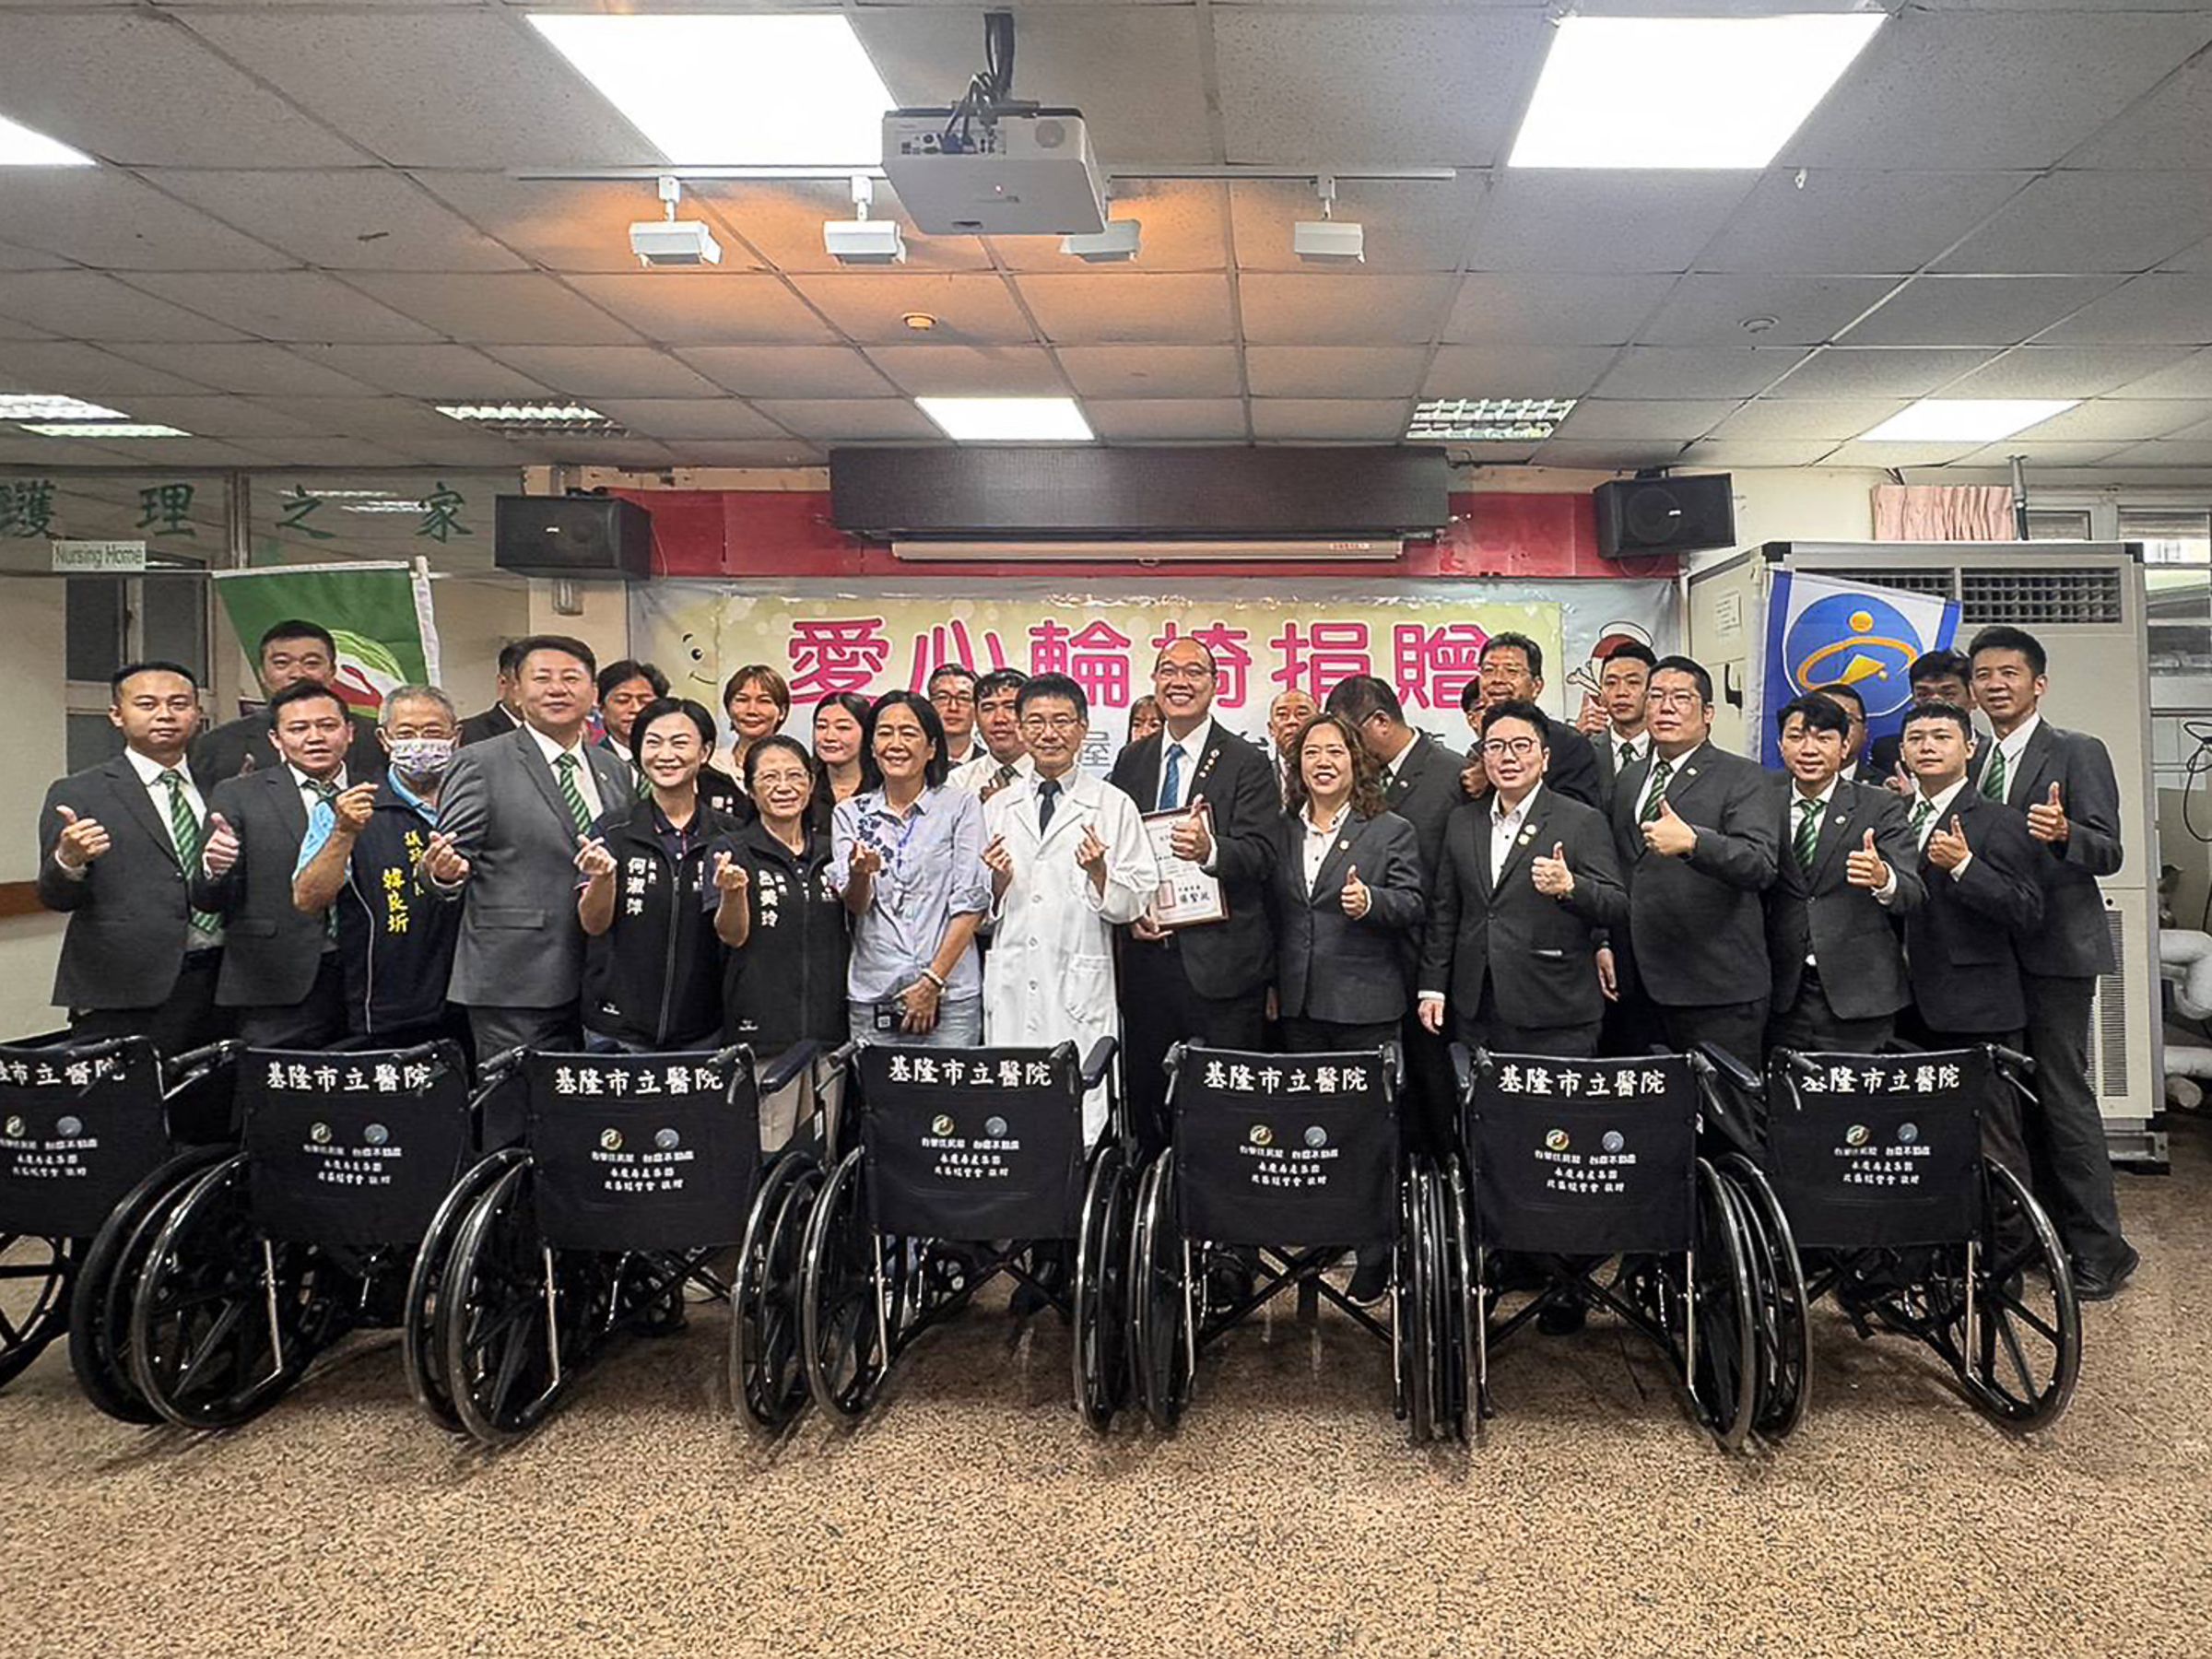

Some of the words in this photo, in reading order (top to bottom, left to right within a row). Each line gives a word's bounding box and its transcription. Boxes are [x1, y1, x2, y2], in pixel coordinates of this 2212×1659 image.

[55, 544, 102, 569] Nursing
[105, 544, 143, 564] Home
[266, 1061, 434, 1093] 基隆市立醫院
[555, 1065, 724, 1097] 基隆市立醫院
[888, 1054, 1053, 1088] 基隆市立醫院
[1203, 1060, 1370, 1095] 基隆市立醫院
[1498, 1064, 1667, 1098] 基隆市立醫院
